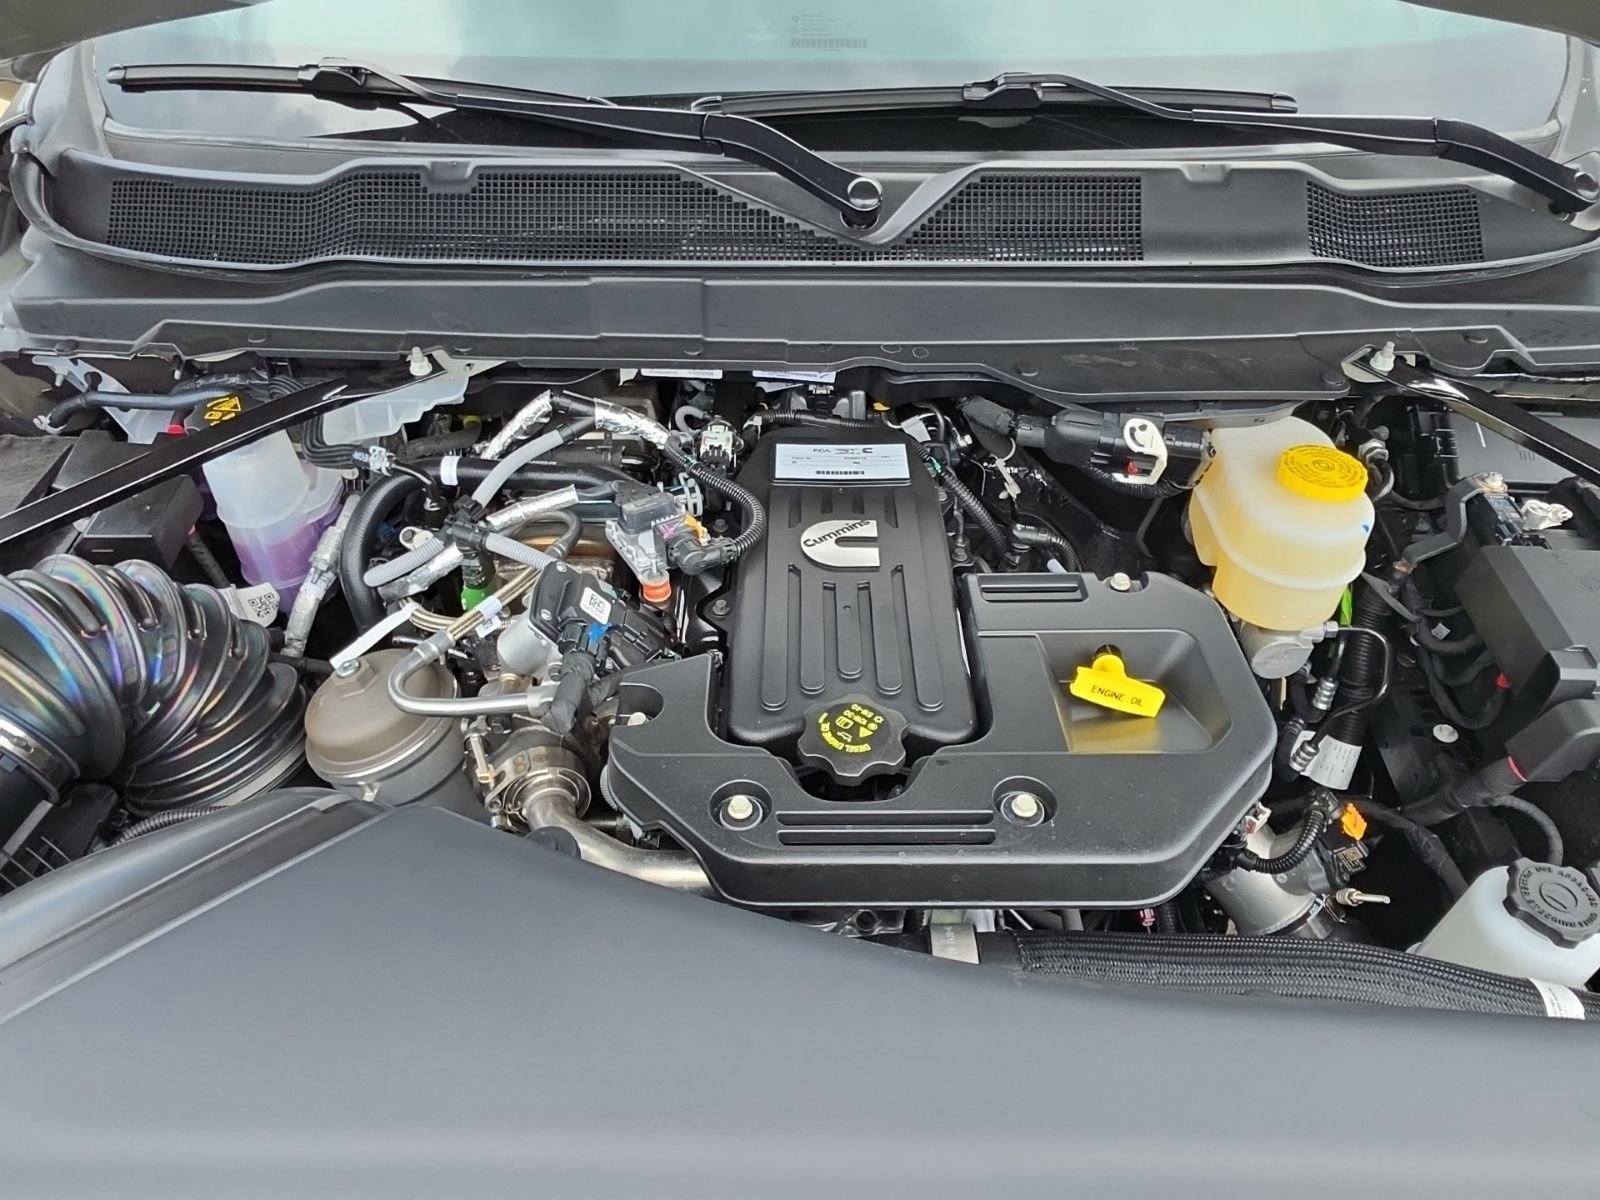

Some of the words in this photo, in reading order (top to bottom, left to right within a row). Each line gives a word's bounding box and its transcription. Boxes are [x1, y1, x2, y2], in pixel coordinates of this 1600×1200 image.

[803, 520, 871, 547] Cummins
[1091, 685, 1125, 702] ENGINE
[1130, 697, 1143, 707] OIL
